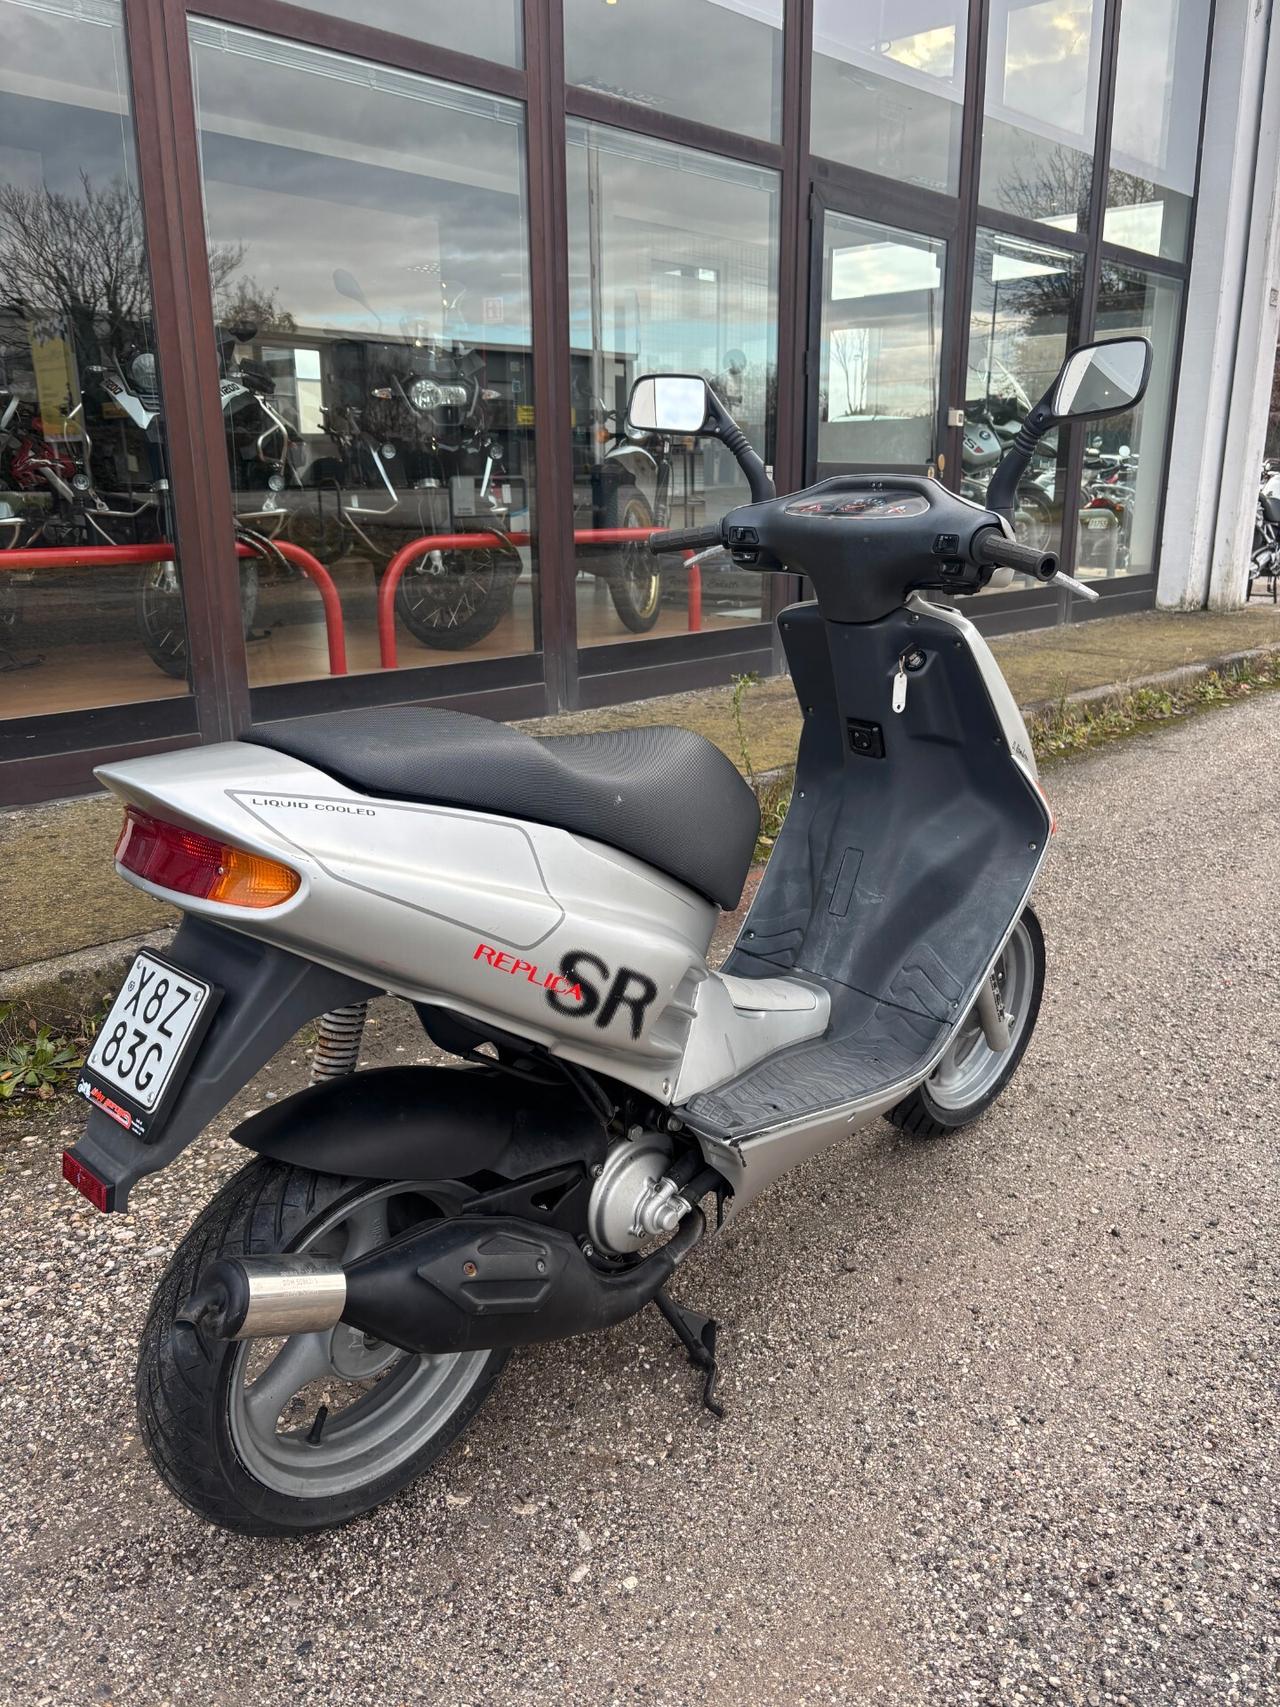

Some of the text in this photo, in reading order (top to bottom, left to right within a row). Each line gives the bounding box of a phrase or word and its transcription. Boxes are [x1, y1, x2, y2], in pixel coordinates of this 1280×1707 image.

[251, 797, 376, 817] LIQUID COOLED
[124, 966, 191, 1039] X8Z
[473, 943, 584, 1001] REPLICA
[544, 948, 659, 1041] SR
[101, 1021, 163, 1091] 83G
